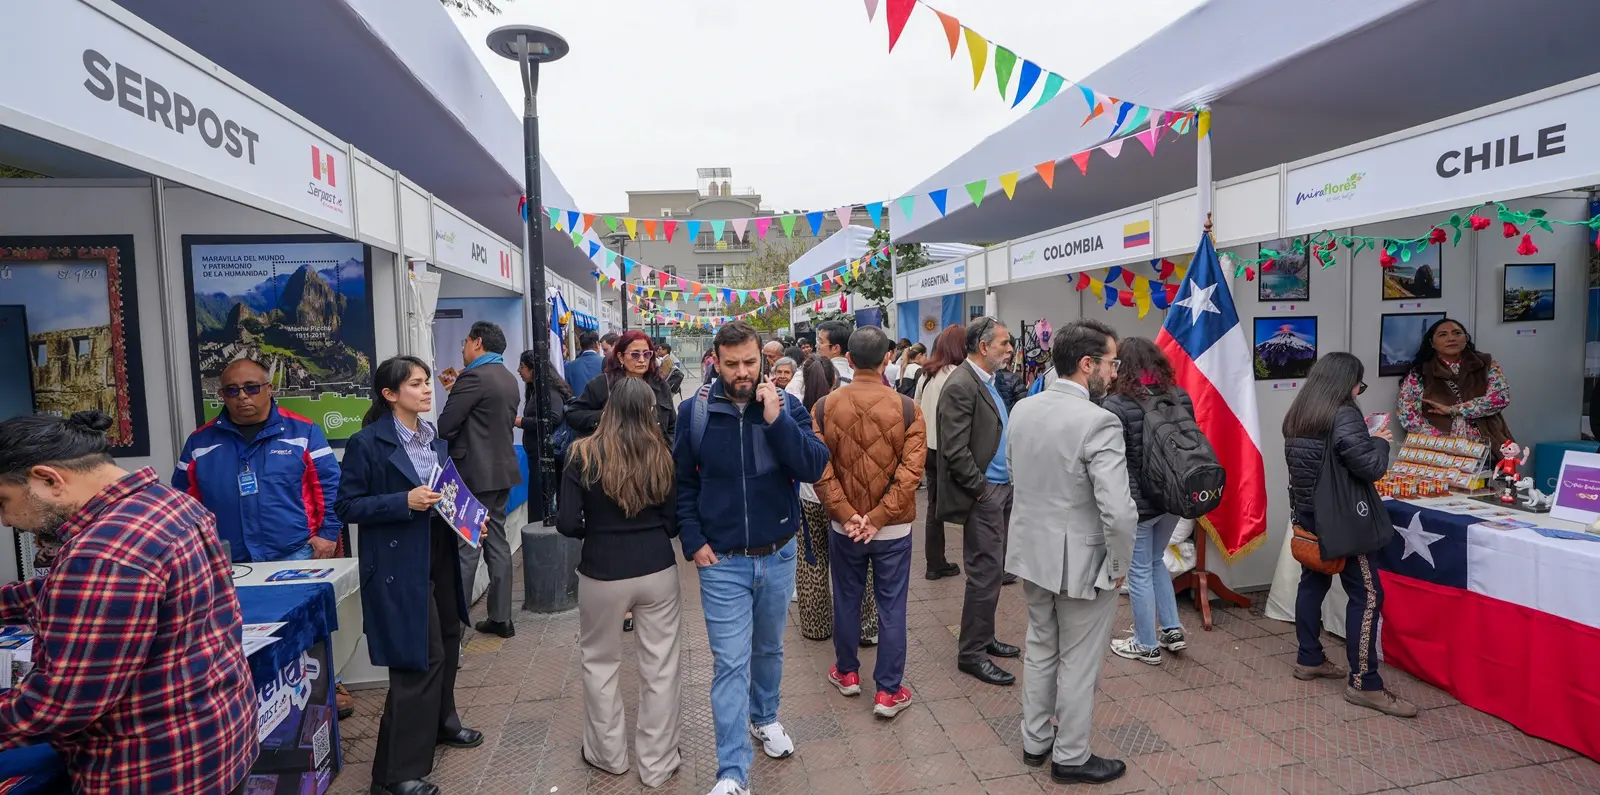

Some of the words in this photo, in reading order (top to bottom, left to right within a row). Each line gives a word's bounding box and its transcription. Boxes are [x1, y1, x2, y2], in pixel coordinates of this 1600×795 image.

[82, 48, 260, 165] SERPOST
[1436, 123, 1567, 178] CHILE
[307, 182, 336, 205] Serpost
[1296, 181, 1357, 206] miraflores
[471, 242, 488, 265] APCI
[1043, 235, 1104, 261] COLOMBIA
[921, 273, 950, 289] ARGENTINA
[1192, 485, 1224, 503] ROXY
